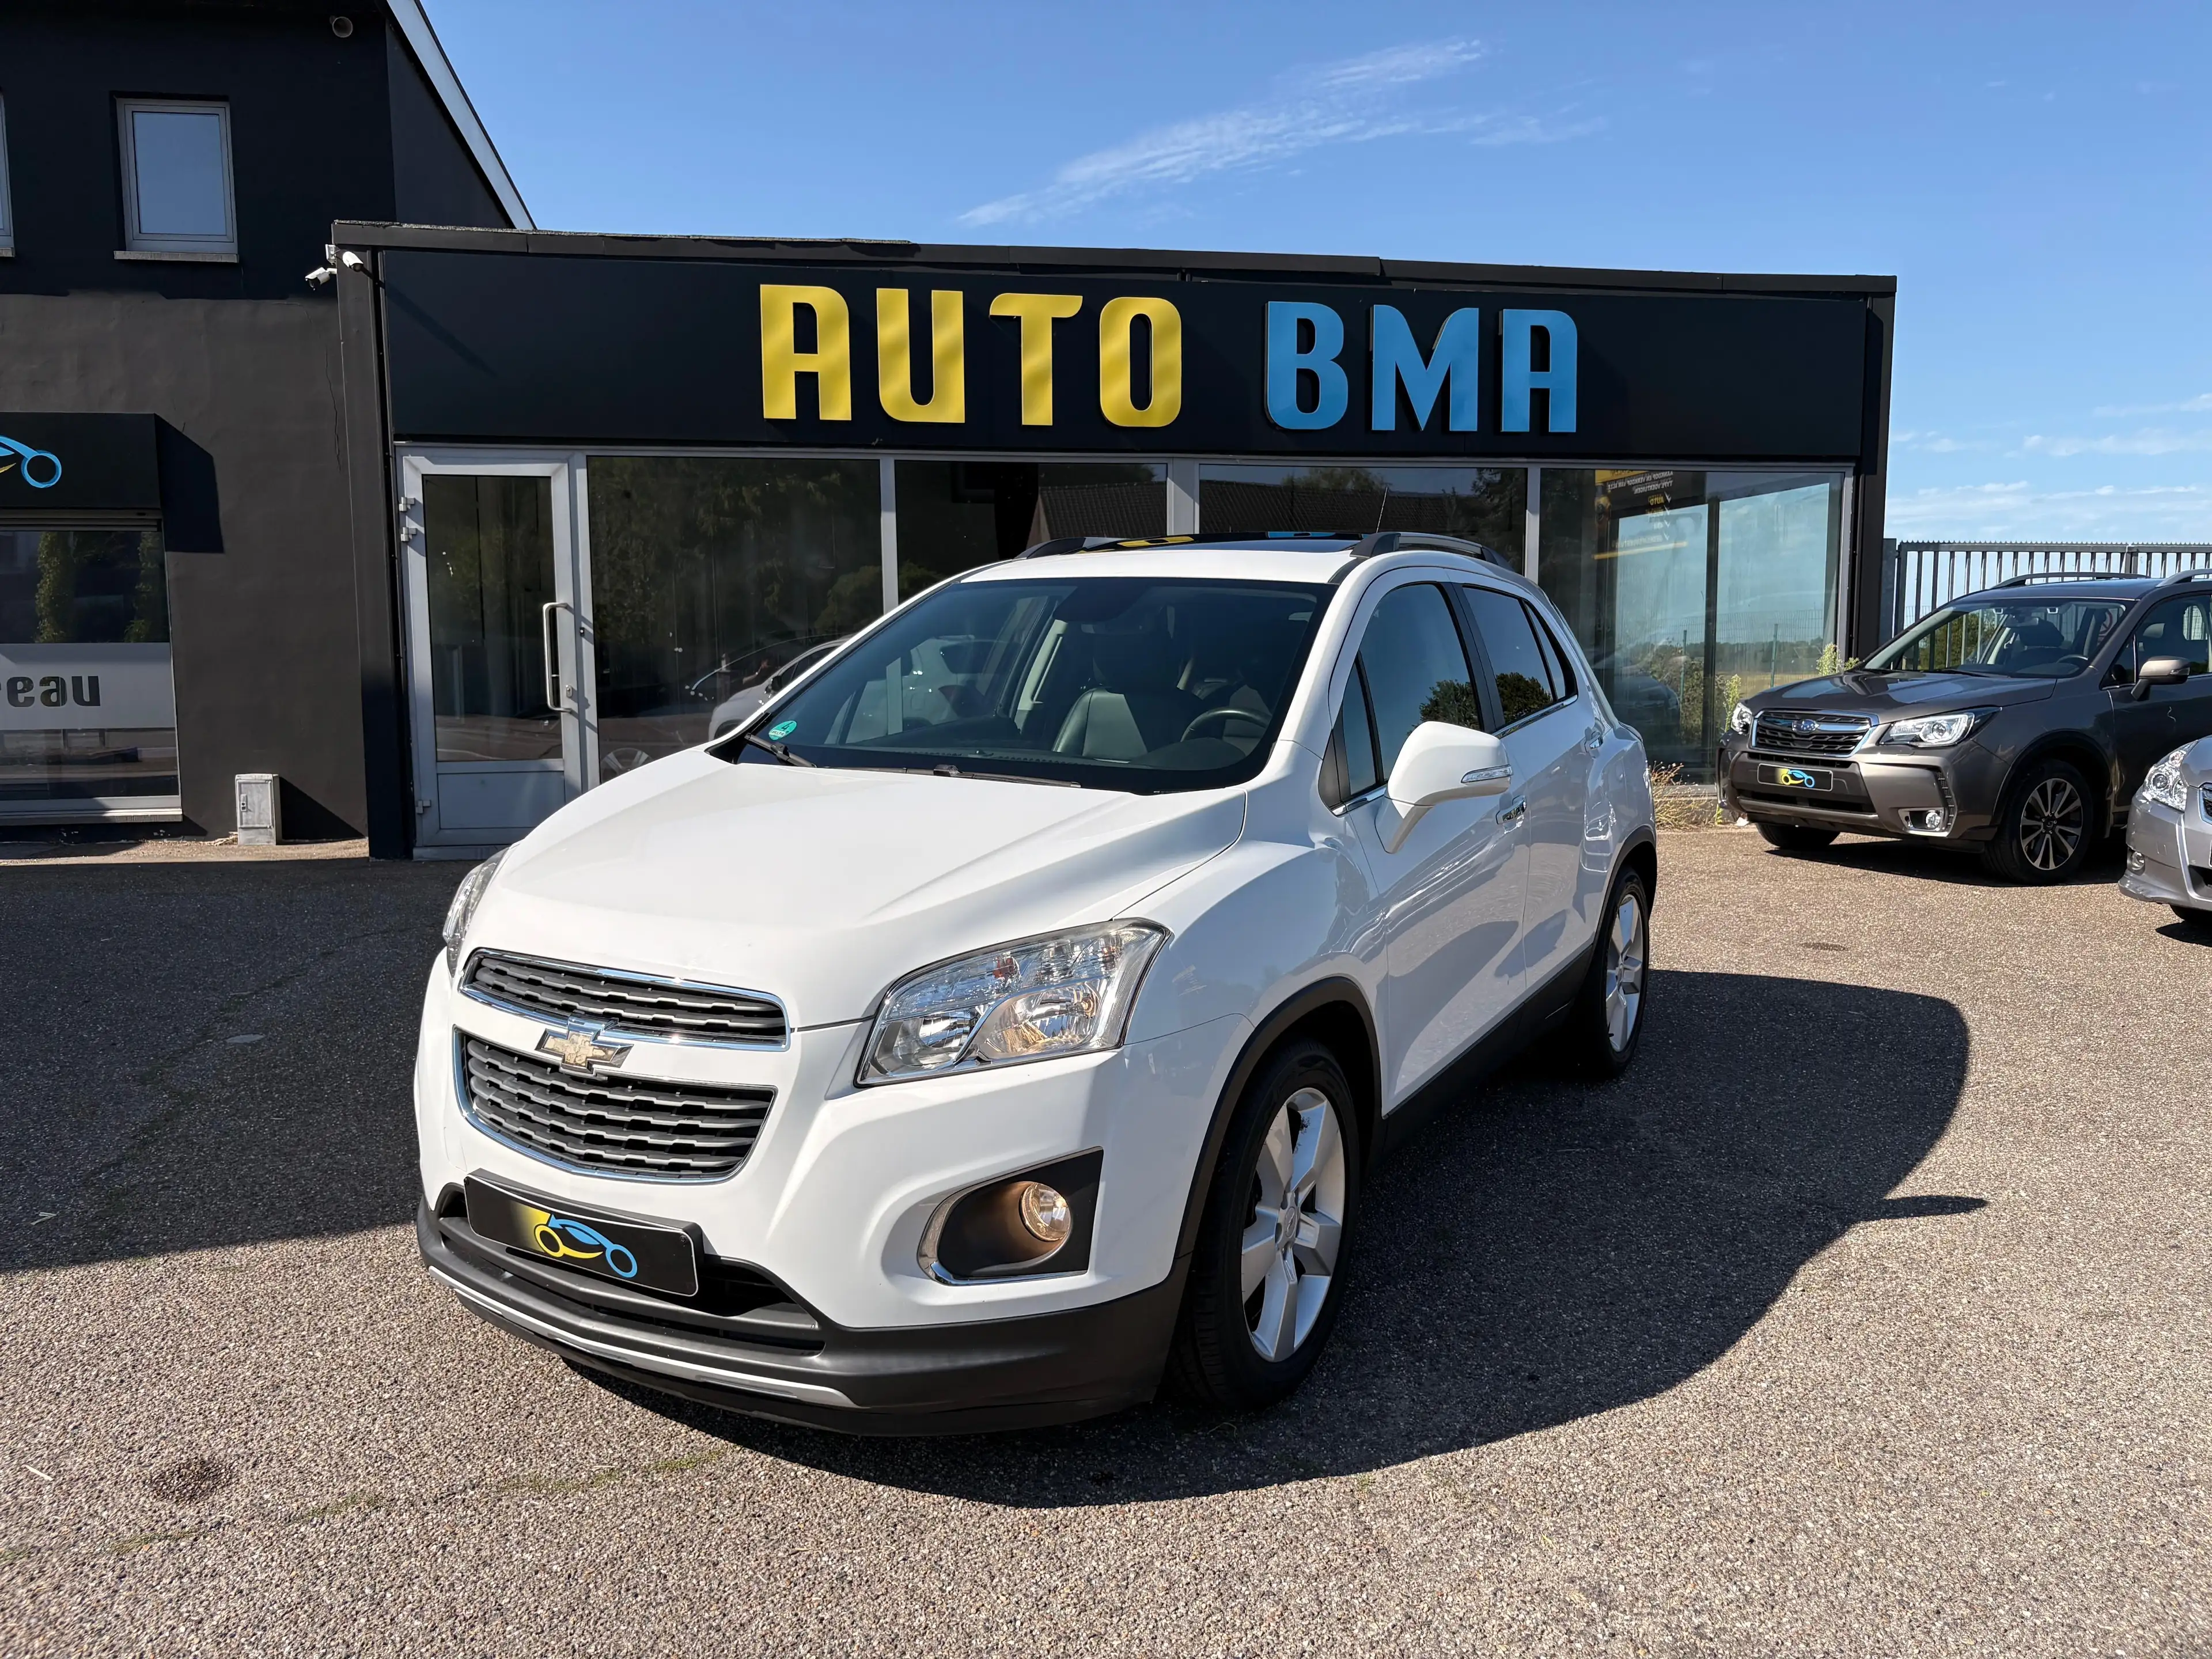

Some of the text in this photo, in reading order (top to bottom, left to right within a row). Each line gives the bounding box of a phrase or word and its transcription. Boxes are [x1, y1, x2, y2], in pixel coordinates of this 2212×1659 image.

[760, 284, 1578, 433] AUTO BMA
[0, 676, 101, 707] eau
[780, 722, 794, 731] 4
